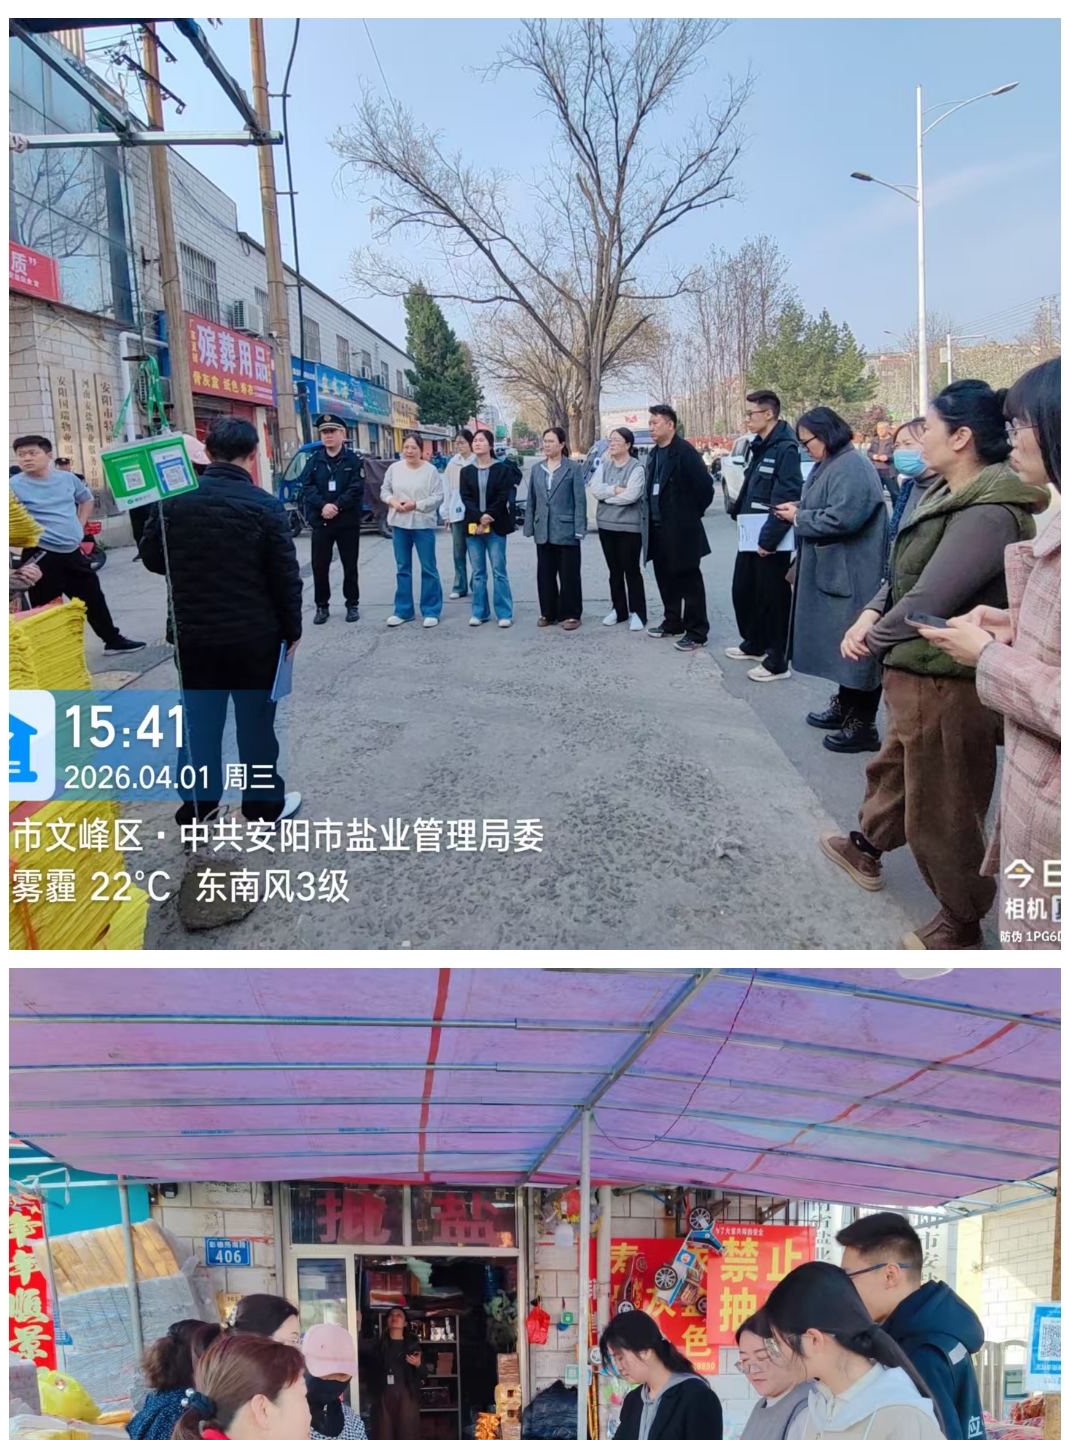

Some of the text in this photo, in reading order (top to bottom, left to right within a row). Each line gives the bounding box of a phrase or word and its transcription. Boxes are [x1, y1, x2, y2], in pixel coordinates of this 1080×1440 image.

[196, 323, 270, 384] 殡葬用品
[216, 1250, 242, 1263] 406
[721, 1237, 803, 1283] 禁止
[720, 1286, 762, 1333] 抽
